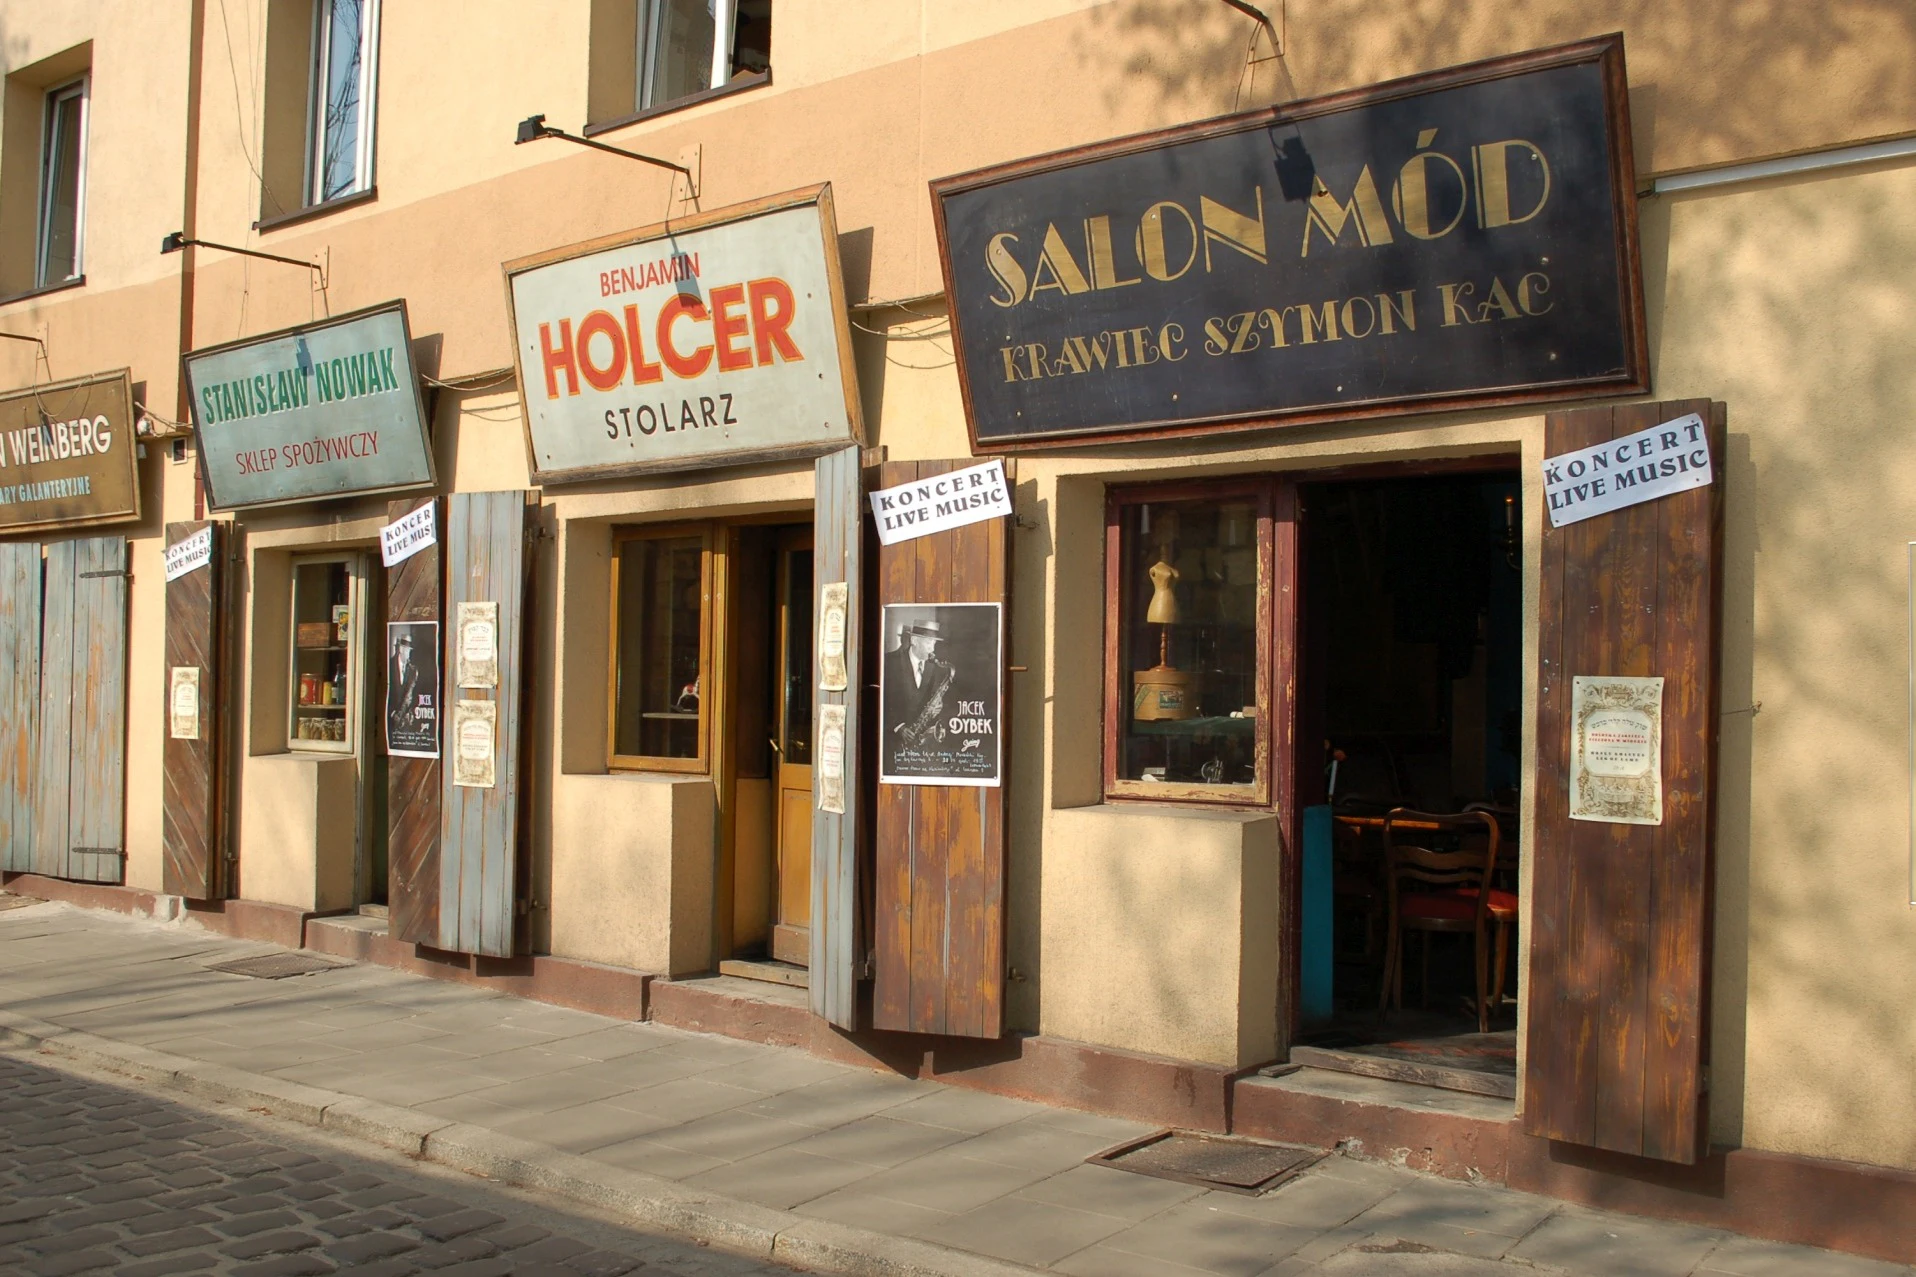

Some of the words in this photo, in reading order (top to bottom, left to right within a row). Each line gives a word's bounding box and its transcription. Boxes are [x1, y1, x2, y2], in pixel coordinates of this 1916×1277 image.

[985, 186, 1268, 308] SALON
[1301, 128, 1550, 257] MÓD
[600, 252, 700, 297] BENJAMIN
[539, 277, 805, 400] HOLCER
[1000, 323, 1188, 383] KRAWIEC
[1204, 290, 1416, 356] SZYMON
[1436, 272, 1555, 328] KAC
[203, 366, 309, 426] STANISŁAW
[315, 347, 400, 404] NOWAK
[605, 393, 737, 439] STOLARZ
[8, 414, 112, 466] WEINBERG
[236, 448, 276, 475] SKLEP
[282, 431, 378, 468] SPOŻYWCZY
[1544, 422, 1700, 486] KONCERT
[19, 475, 91, 502] GALANTERYJNE
[880, 468, 999, 511] KONCERT
[1548, 478, 1606, 510] LIVE
[1614, 450, 1708, 491] MUSIC
[385, 509, 431, 541] KONCER
[884, 507, 929, 531] LIVE
[936, 488, 1004, 518] MUSIC
[167, 558, 184, 573] LIVE
[387, 537, 409, 556] LIVE
[949, 717, 993, 735] DYBEK
[957, 700, 985, 717] JACEK
